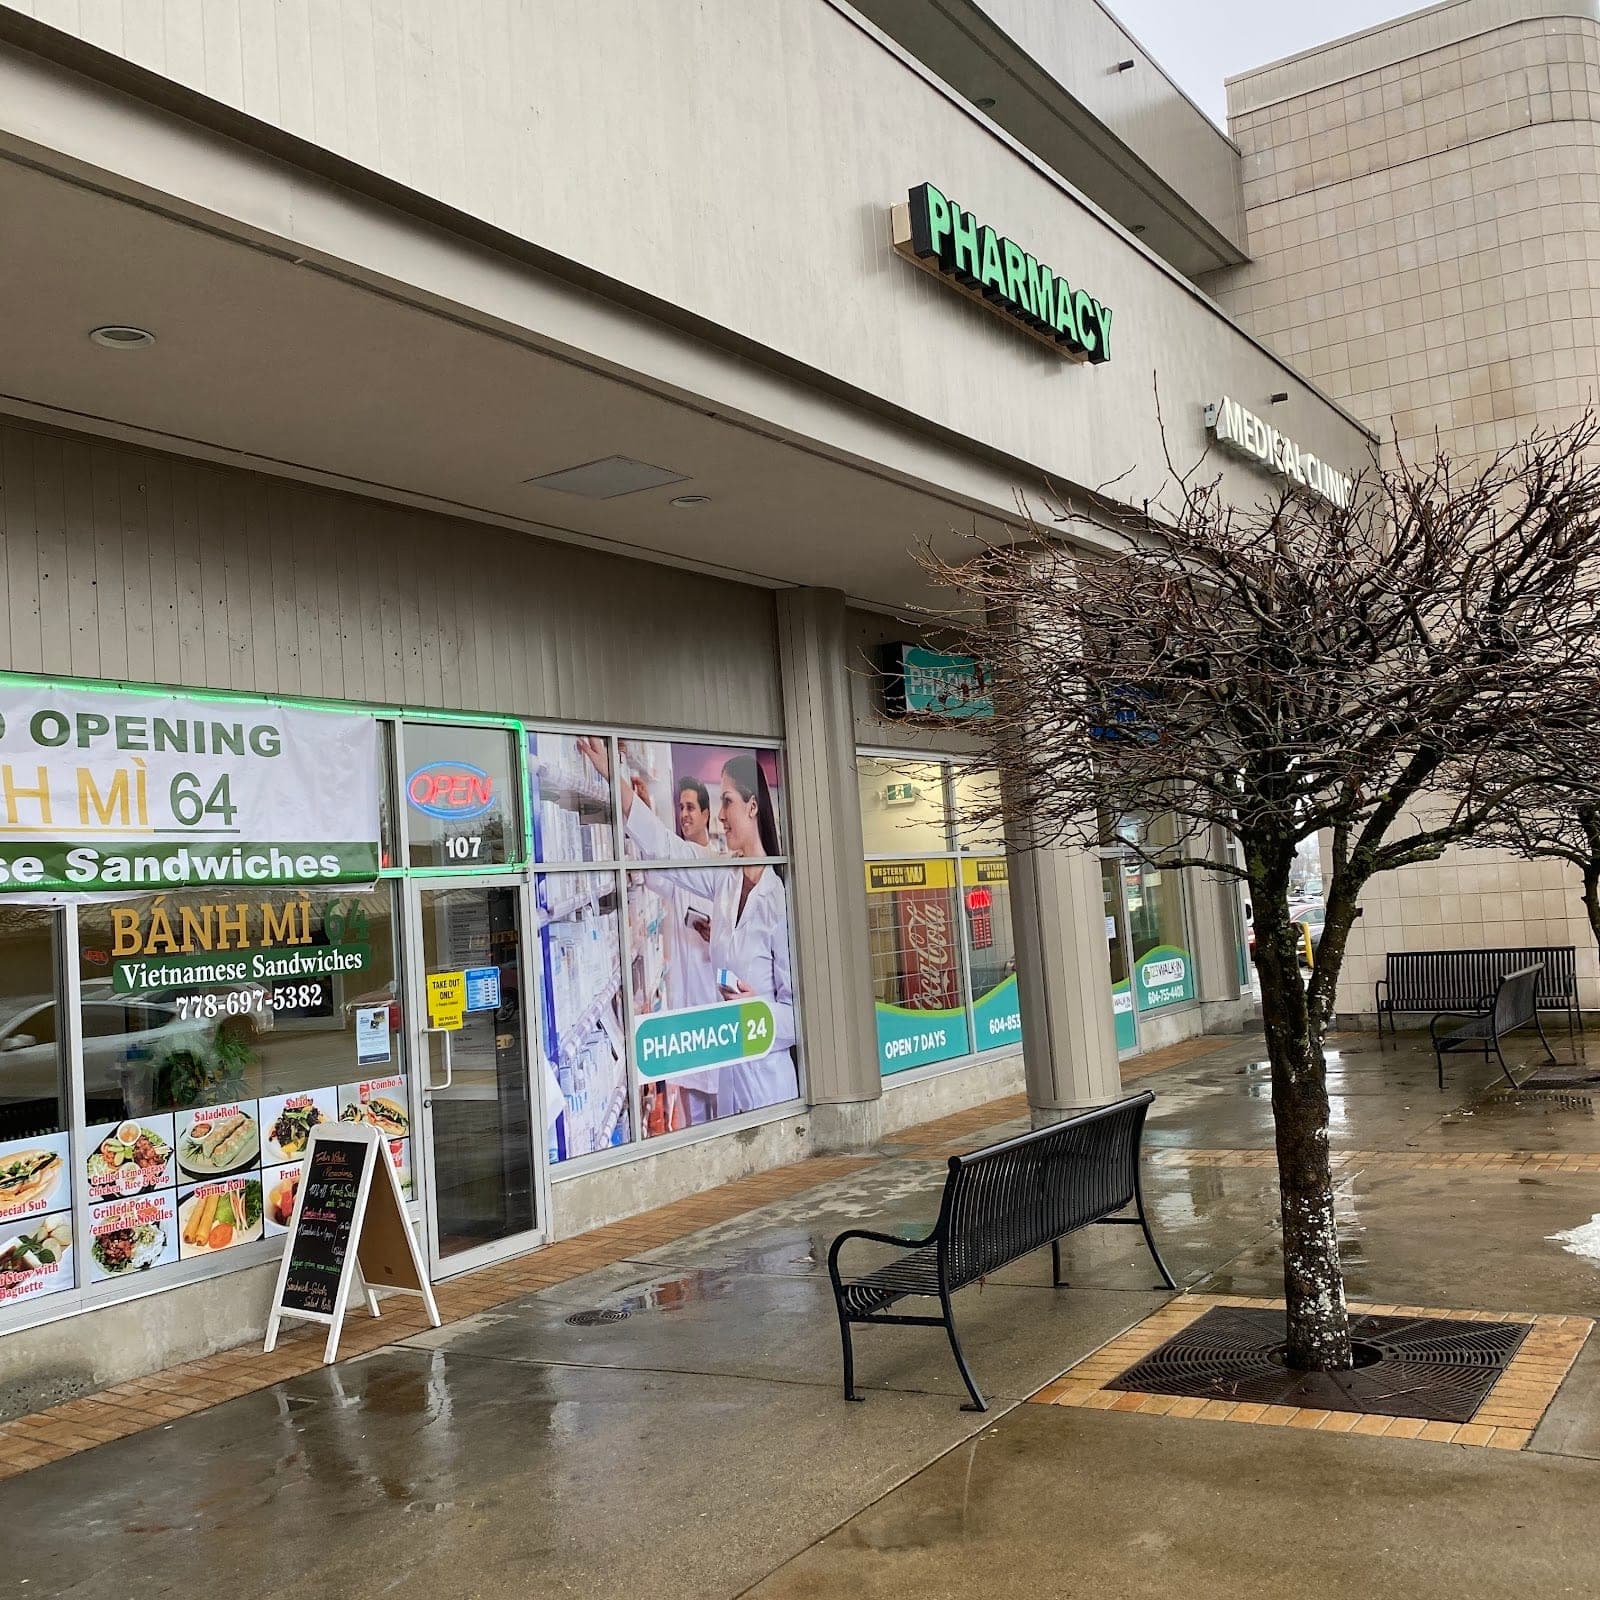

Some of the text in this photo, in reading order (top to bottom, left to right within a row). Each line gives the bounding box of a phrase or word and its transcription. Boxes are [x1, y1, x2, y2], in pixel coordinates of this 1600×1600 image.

[925, 182, 1113, 361] PHARMACY
[1216, 395, 1306, 487] MEDICAL
[29, 709, 282, 758] OPENING
[76, 756, 149, 826] MÌ
[169, 771, 238, 826] 64
[410, 772, 493, 805] OPEN
[445, 836, 482, 858] 107
[64, 847, 341, 883] Sandwiches
[872, 867, 903, 876] WESTERN
[882, 875, 904, 885] UNION
[111, 889, 370, 957] BÁNH MÌ 64
[120, 948, 363, 990] Vietnamese Sandwiches
[176, 983, 323, 1021] 778-697-5382
[642, 1017, 768, 1061] PHARMACY 24
[885, 1029, 947, 1059] OPEN 7 DAYS
[195, 1105, 239, 1121] Salad Roll
[93, 1172, 119, 1184] Grilled
[125, 1180, 141, 1190] Rice
[151, 1175, 170, 1185] Soup
[280, 1168, 300, 1180] Fruit
[195, 1178, 245, 1199] Spring Roll
[28, 1199, 47, 1212] Sub
[93, 1197, 165, 1220] Grilled Pork on
[137, 1209, 174, 1223] Noodles
[6, 1271, 31, 1283] Stew
[33, 1262, 59, 1276] with
